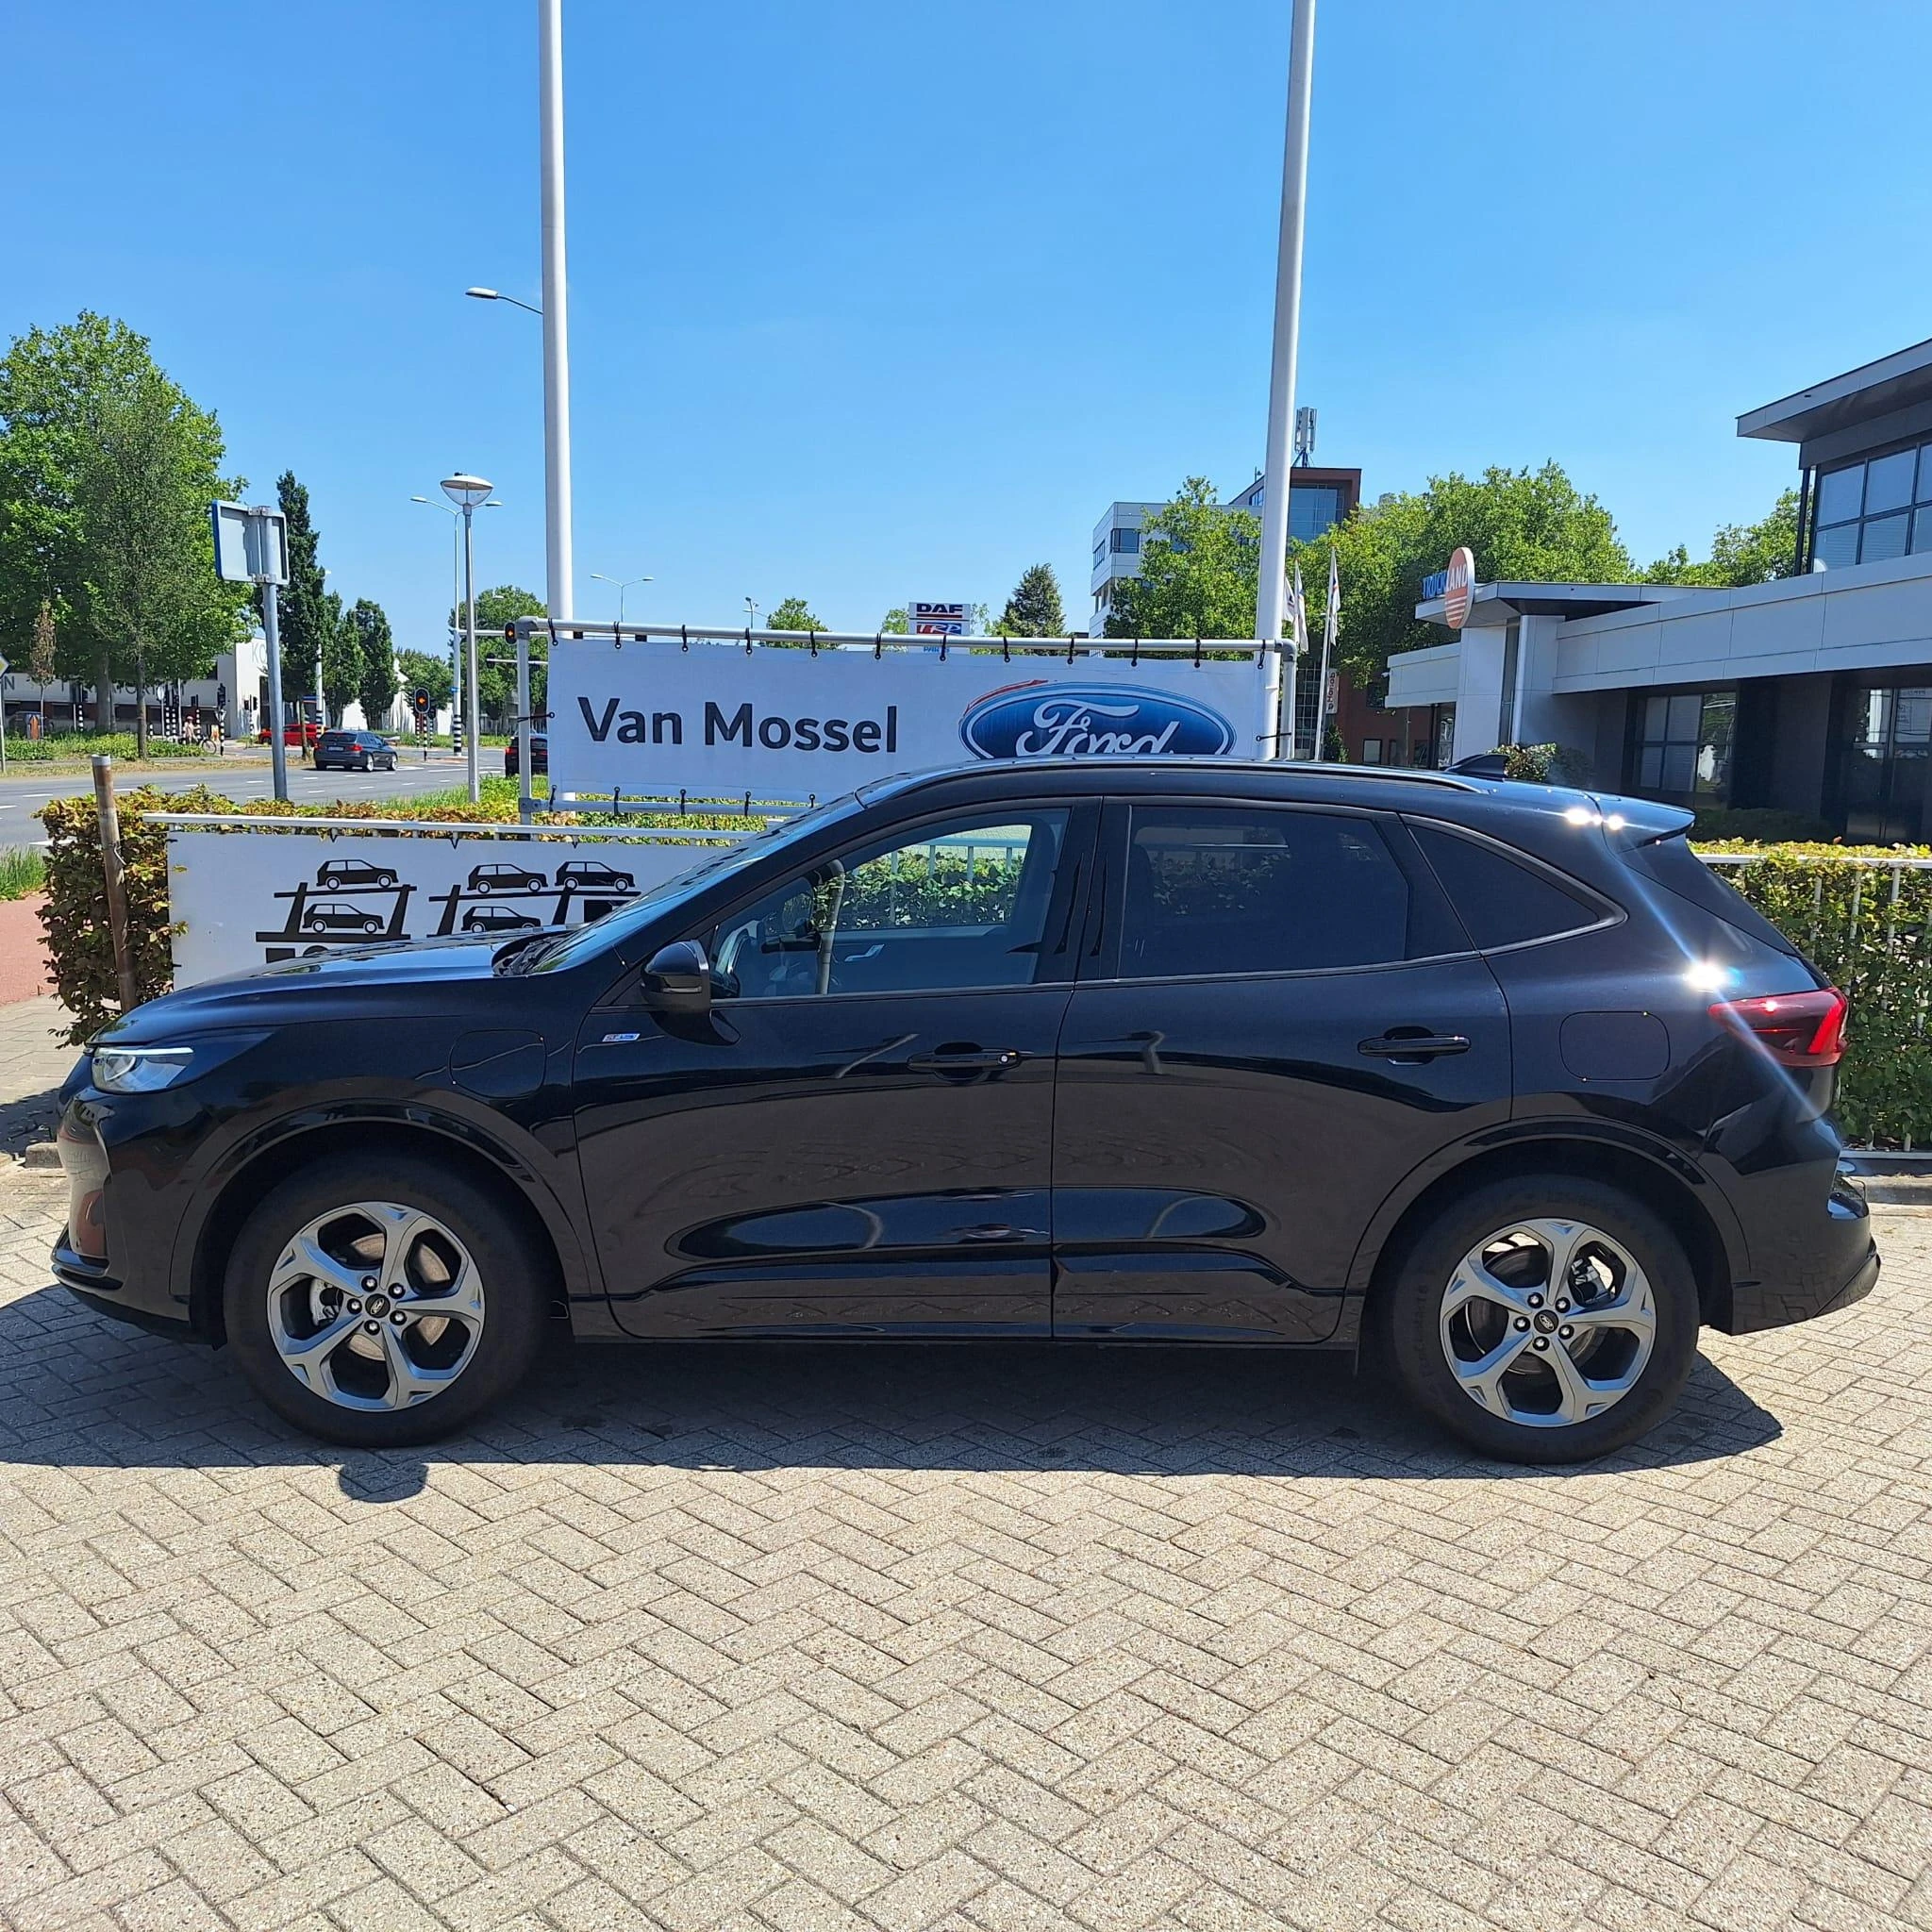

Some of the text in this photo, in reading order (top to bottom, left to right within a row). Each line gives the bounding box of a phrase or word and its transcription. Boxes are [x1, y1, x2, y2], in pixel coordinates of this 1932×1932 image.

[916, 604, 963, 613] DAF
[577, 697, 898, 754] Van Mossel
[1016, 698, 1180, 756] Ford
